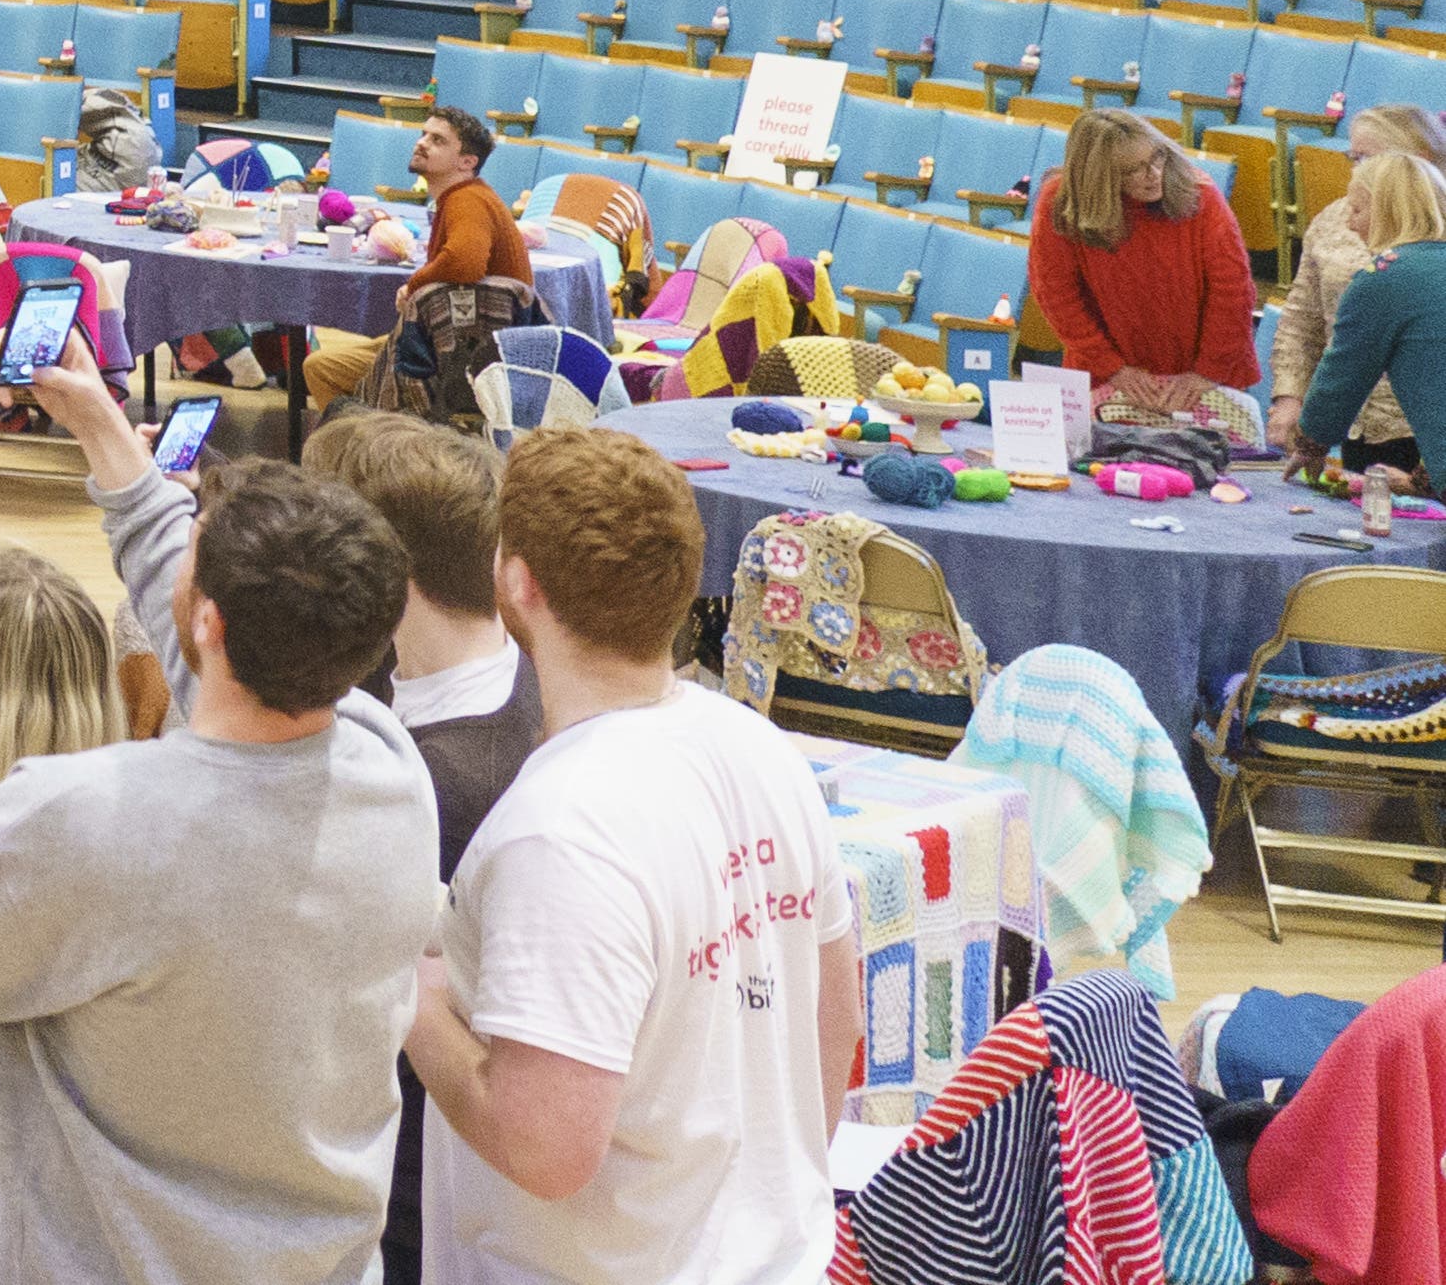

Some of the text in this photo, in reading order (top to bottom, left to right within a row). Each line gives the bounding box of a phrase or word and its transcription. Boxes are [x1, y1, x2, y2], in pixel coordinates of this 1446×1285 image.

[763, 96, 813, 115] please
[759, 118, 809, 137] thread
[745, 139, 811, 161] carefully
